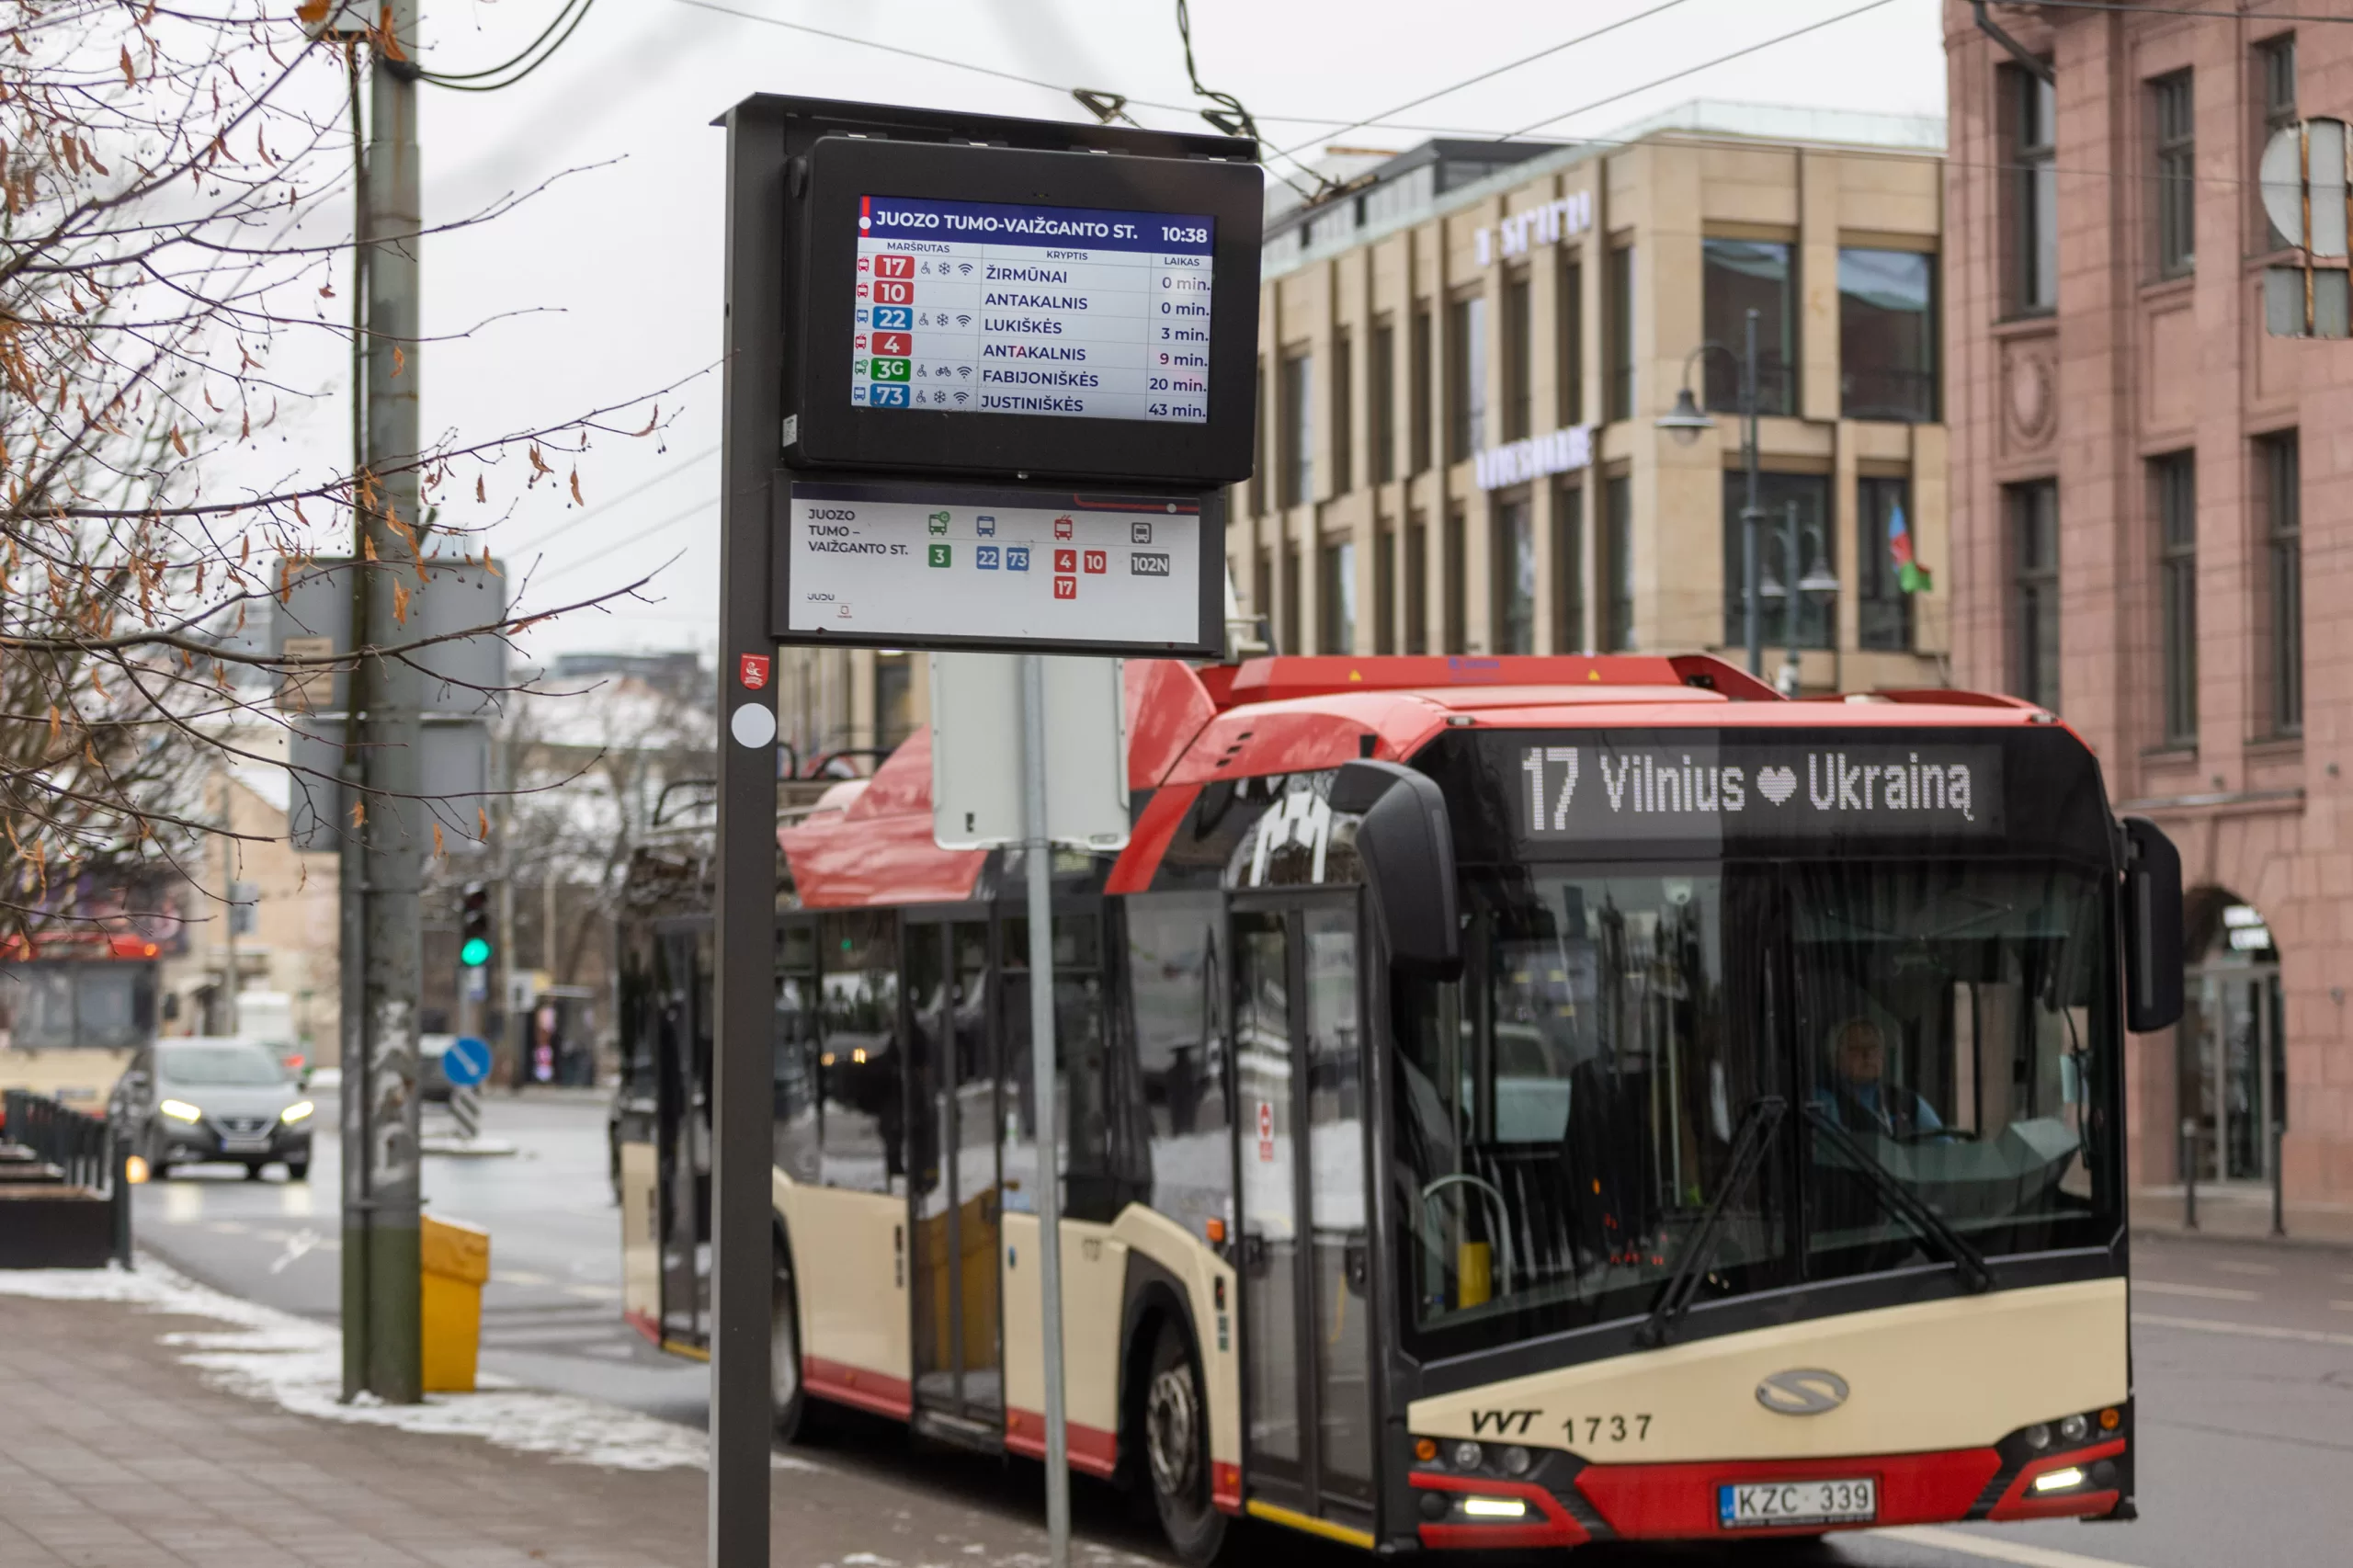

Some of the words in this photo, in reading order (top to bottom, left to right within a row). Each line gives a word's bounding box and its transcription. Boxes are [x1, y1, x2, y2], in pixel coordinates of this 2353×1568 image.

[876, 210, 939, 228] JUOZO
[944, 214, 1108, 237] TUMO-VAIŽGANTO
[1113, 224, 1138, 239] ST.
[1162, 227, 1207, 243] 10:38
[887, 241, 949, 253] MARŠRUTAS
[1047, 251, 1087, 260] KRYPTIS
[1165, 256, 1199, 266] LAIKAS
[882, 257, 906, 276] 17
[986, 264, 1067, 283] ŽIRMŪNAI
[1162, 277, 1172, 289] 0
[1176, 278, 1211, 290] min.
[881, 284, 905, 302] 10
[985, 293, 1087, 310] ANTAKALNIS
[1161, 302, 1171, 313] 0
[1176, 302, 1210, 316] min.
[879, 310, 906, 327] 22
[985, 317, 1062, 334] LUKIŠKĖS
[1161, 328, 1170, 339] 3
[1175, 328, 1209, 341] min.
[884, 335, 900, 353] 4
[983, 345, 1086, 360] ANTAKALNIS
[1160, 353, 1169, 365] 9
[1174, 353, 1208, 367] min.
[877, 360, 904, 378] 3G
[983, 370, 1098, 387] FABIJONIŠKĖS
[1149, 378, 1168, 390] 20
[1173, 379, 1207, 392] min.
[876, 386, 904, 405] 73
[981, 395, 1084, 412] JUSTINIŠKĖS
[1149, 403, 1167, 415] 43
[1172, 404, 1206, 417] min.
[808, 508, 855, 521] JUOZO
[808, 525, 849, 536] TUMO
[808, 540, 886, 555] VAIŽGANTO
[890, 544, 908, 555] ST.
[934, 549, 945, 563] 3
[979, 551, 997, 565] 22
[1008, 552, 1027, 566] 73
[1060, 554, 1072, 568] 4
[1086, 555, 1103, 570] 10
[1132, 557, 1168, 572] 102N
[1057, 581, 1074, 595] 17
[1522, 747, 1579, 831] 17
[1599, 754, 1745, 812] Vilnius
[1808, 752, 1974, 821] Ukrainą
[1471, 1409, 1543, 1435] VVT
[1562, 1413, 1653, 1445] 1737
[1739, 1484, 1798, 1516] KZC
[1820, 1483, 1869, 1511] 339
